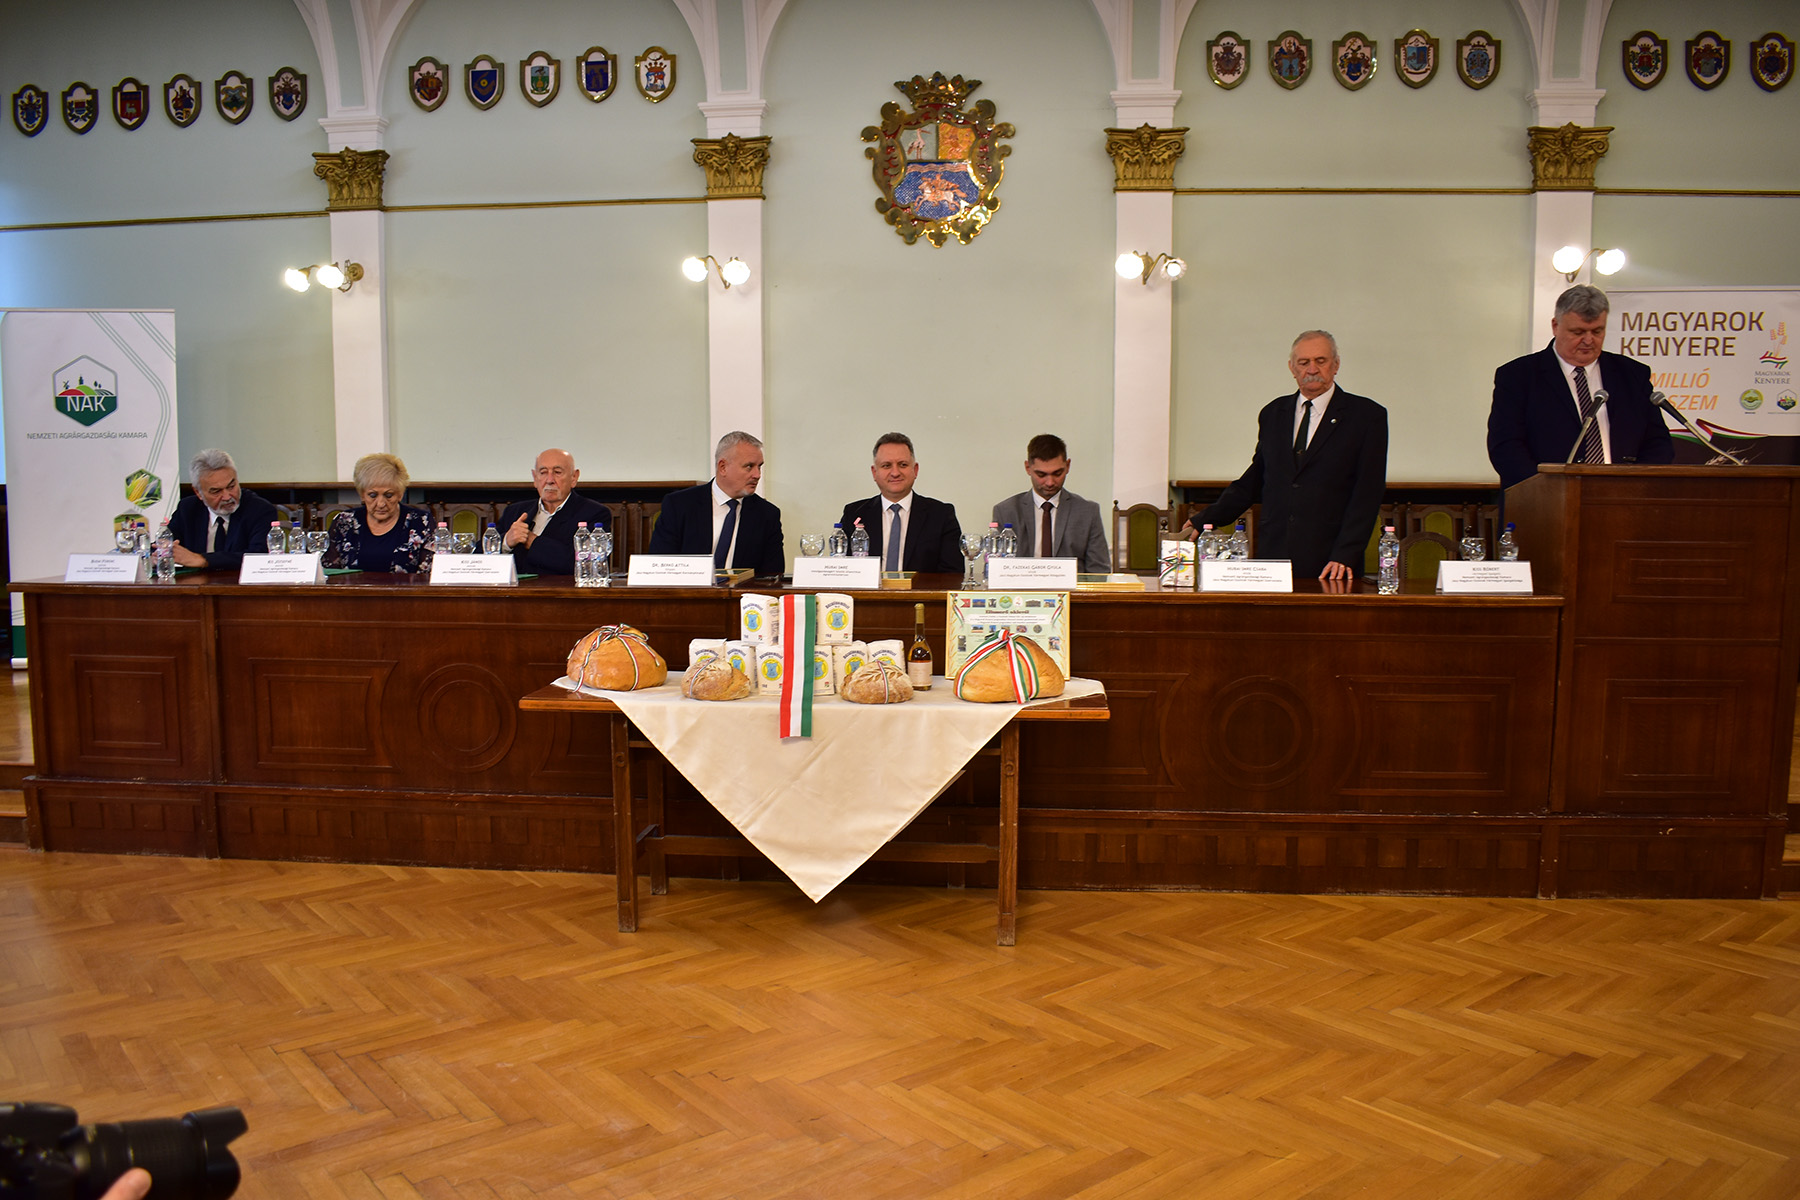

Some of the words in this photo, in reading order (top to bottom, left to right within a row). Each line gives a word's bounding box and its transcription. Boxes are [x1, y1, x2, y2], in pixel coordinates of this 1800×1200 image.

[1621, 311, 1765, 332] MAGYAROK
[1620, 336, 1737, 357] KENYERE
[1649, 367, 1711, 389] MILLIÓ
[66, 395, 106, 412] NAK
[26, 432, 58, 440] NEMZETI
[59, 431, 118, 439] AGRÁRGAZDASÁGI
